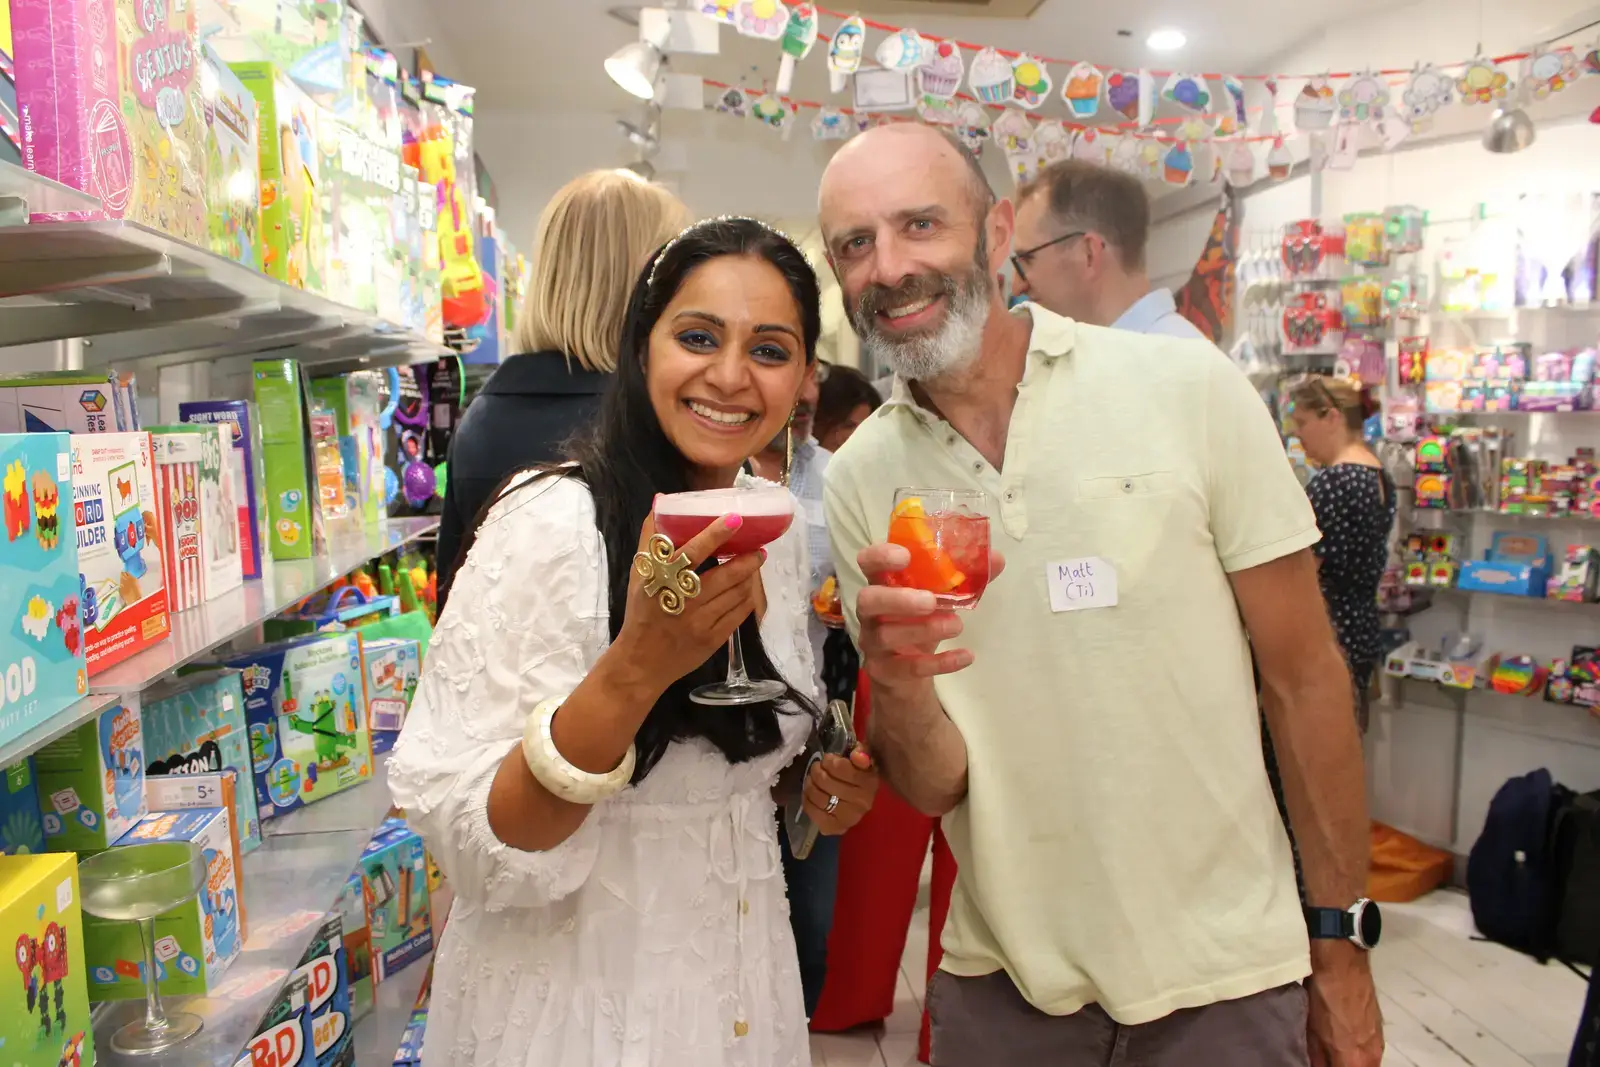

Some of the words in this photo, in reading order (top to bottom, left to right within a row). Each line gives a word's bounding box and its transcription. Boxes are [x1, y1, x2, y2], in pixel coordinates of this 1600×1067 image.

[136, 40, 191, 84] GENIUS
[24, 115, 33, 143] make
[189, 411, 212, 421] SIGHT
[213, 410, 238, 420] WORD
[76, 503, 102, 524] ORD
[174, 500, 198, 525] POP
[1059, 562, 1093, 581] Matt
[1066, 582, 1094, 600] (Ti)
[24, 699, 38, 717] SET
[197, 785, 215, 798] 5+
